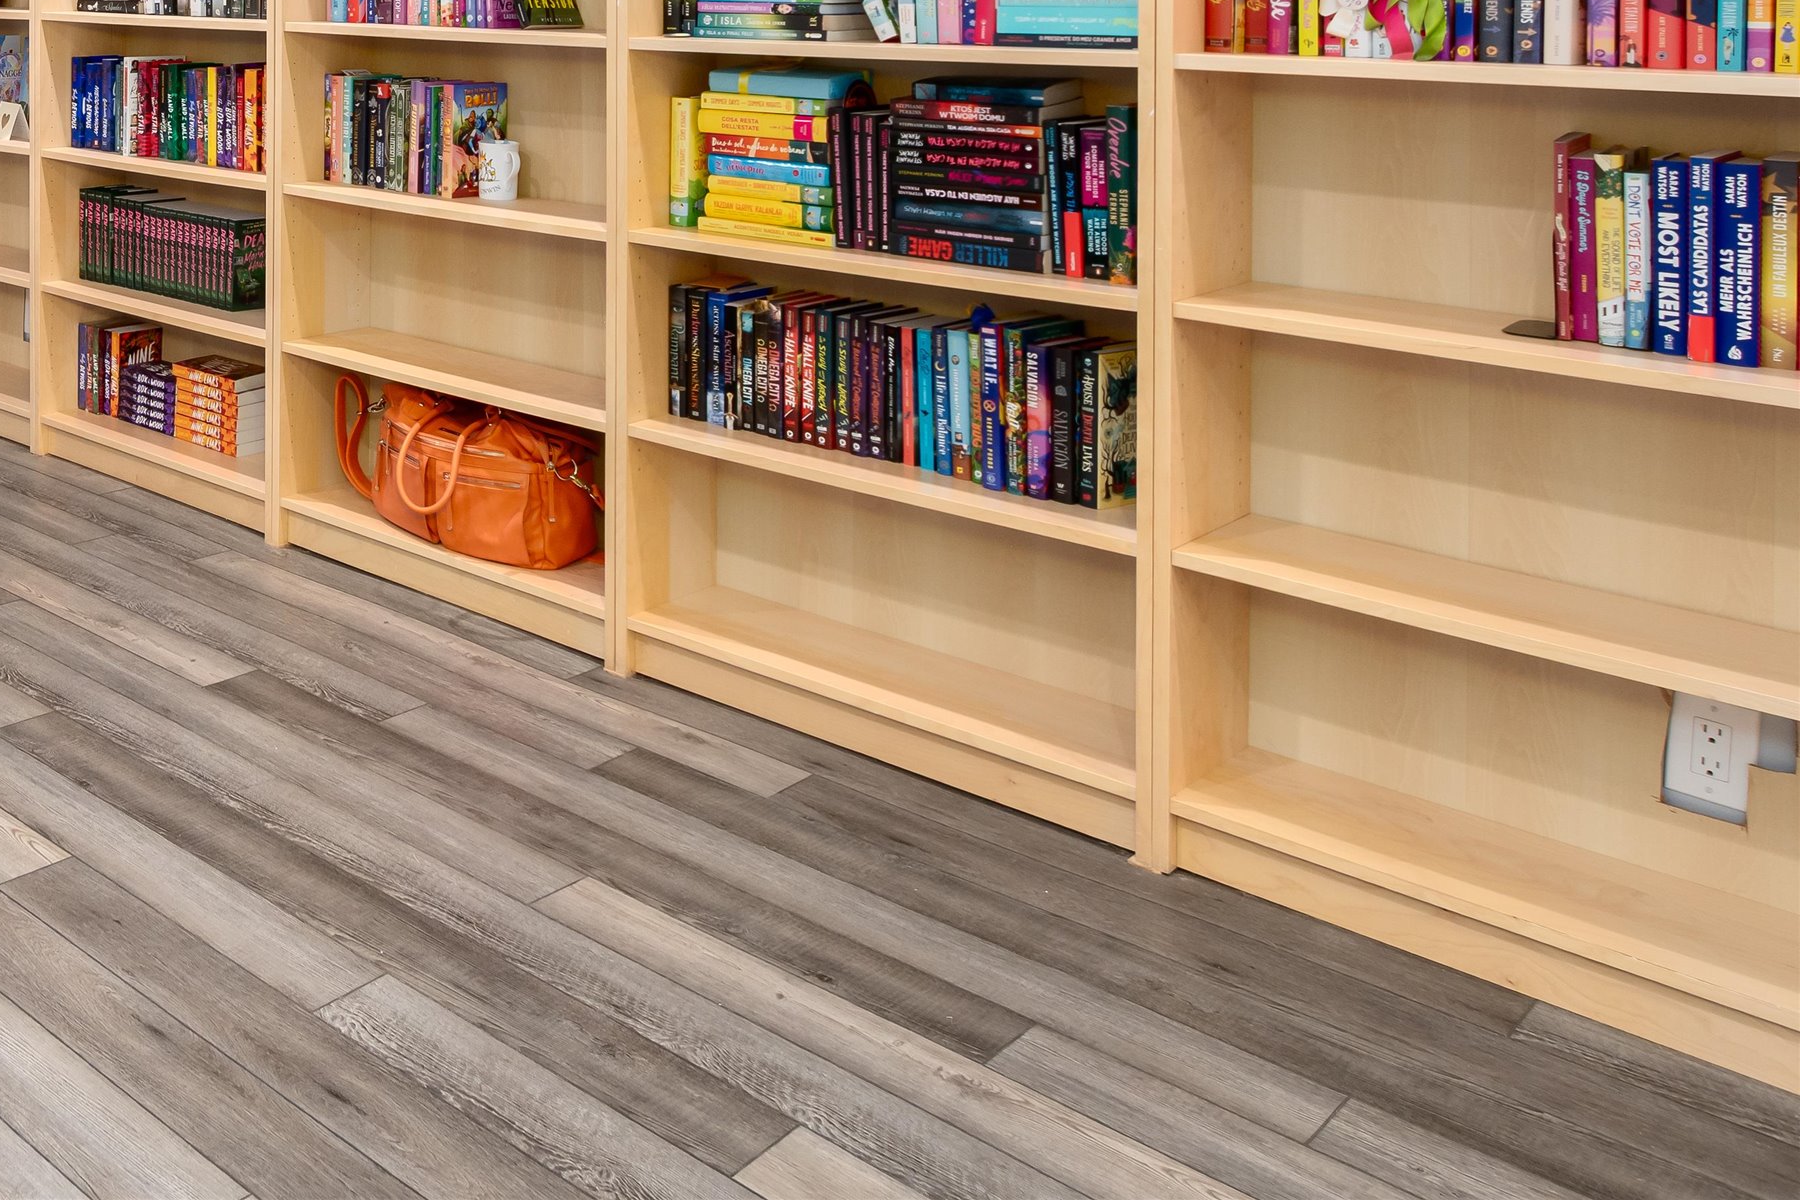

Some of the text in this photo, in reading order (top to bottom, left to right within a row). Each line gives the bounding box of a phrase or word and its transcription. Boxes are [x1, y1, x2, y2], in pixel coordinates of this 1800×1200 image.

[721, 16, 742, 25] ISLA
[465, 93, 498, 108] ROLL!
[722, 123, 759, 132] DELL'ESTATE
[740, 117, 759, 125] RESTA
[1658, 166, 1667, 200] WATSON
[1668, 170, 1679, 198] SARAH
[1692, 165, 1700, 188] SARAH
[1701, 163, 1710, 192] WATSON
[1725, 176, 1735, 204] SARAH
[1736, 173, 1747, 208] WATSON
[1119, 190, 1129, 229] STEPHANIE
[907, 235, 1009, 267] KILLER GAME
[1629, 221, 1641, 253] VOTE
[1772, 195, 1788, 298] UN FABULEUX DESTIN
[1629, 254, 1641, 276] FOR
[1657, 211, 1680, 332] MOST LIKELY
[1692, 205, 1709, 315] LAS CANDIDATAS
[1629, 279, 1641, 294] ME
[1719, 248, 1734, 313] MEHR ALS
[1736, 223, 1753, 341] WAHRSCHEINLICH
[128, 341, 156, 366] NINE
[671, 324, 685, 381] Rampant
[724, 330, 735, 384] Ascendant
[784, 336, 795, 362] HALL
[984, 338, 997, 375] WHAT
[204, 374, 219, 388] LIARS
[743, 357, 752, 407] OMEGA CITY
[784, 375, 796, 407] KNIFE
[1083, 376, 1095, 406] HOUSE
[1082, 414, 1093, 473] DEATH LIVES
